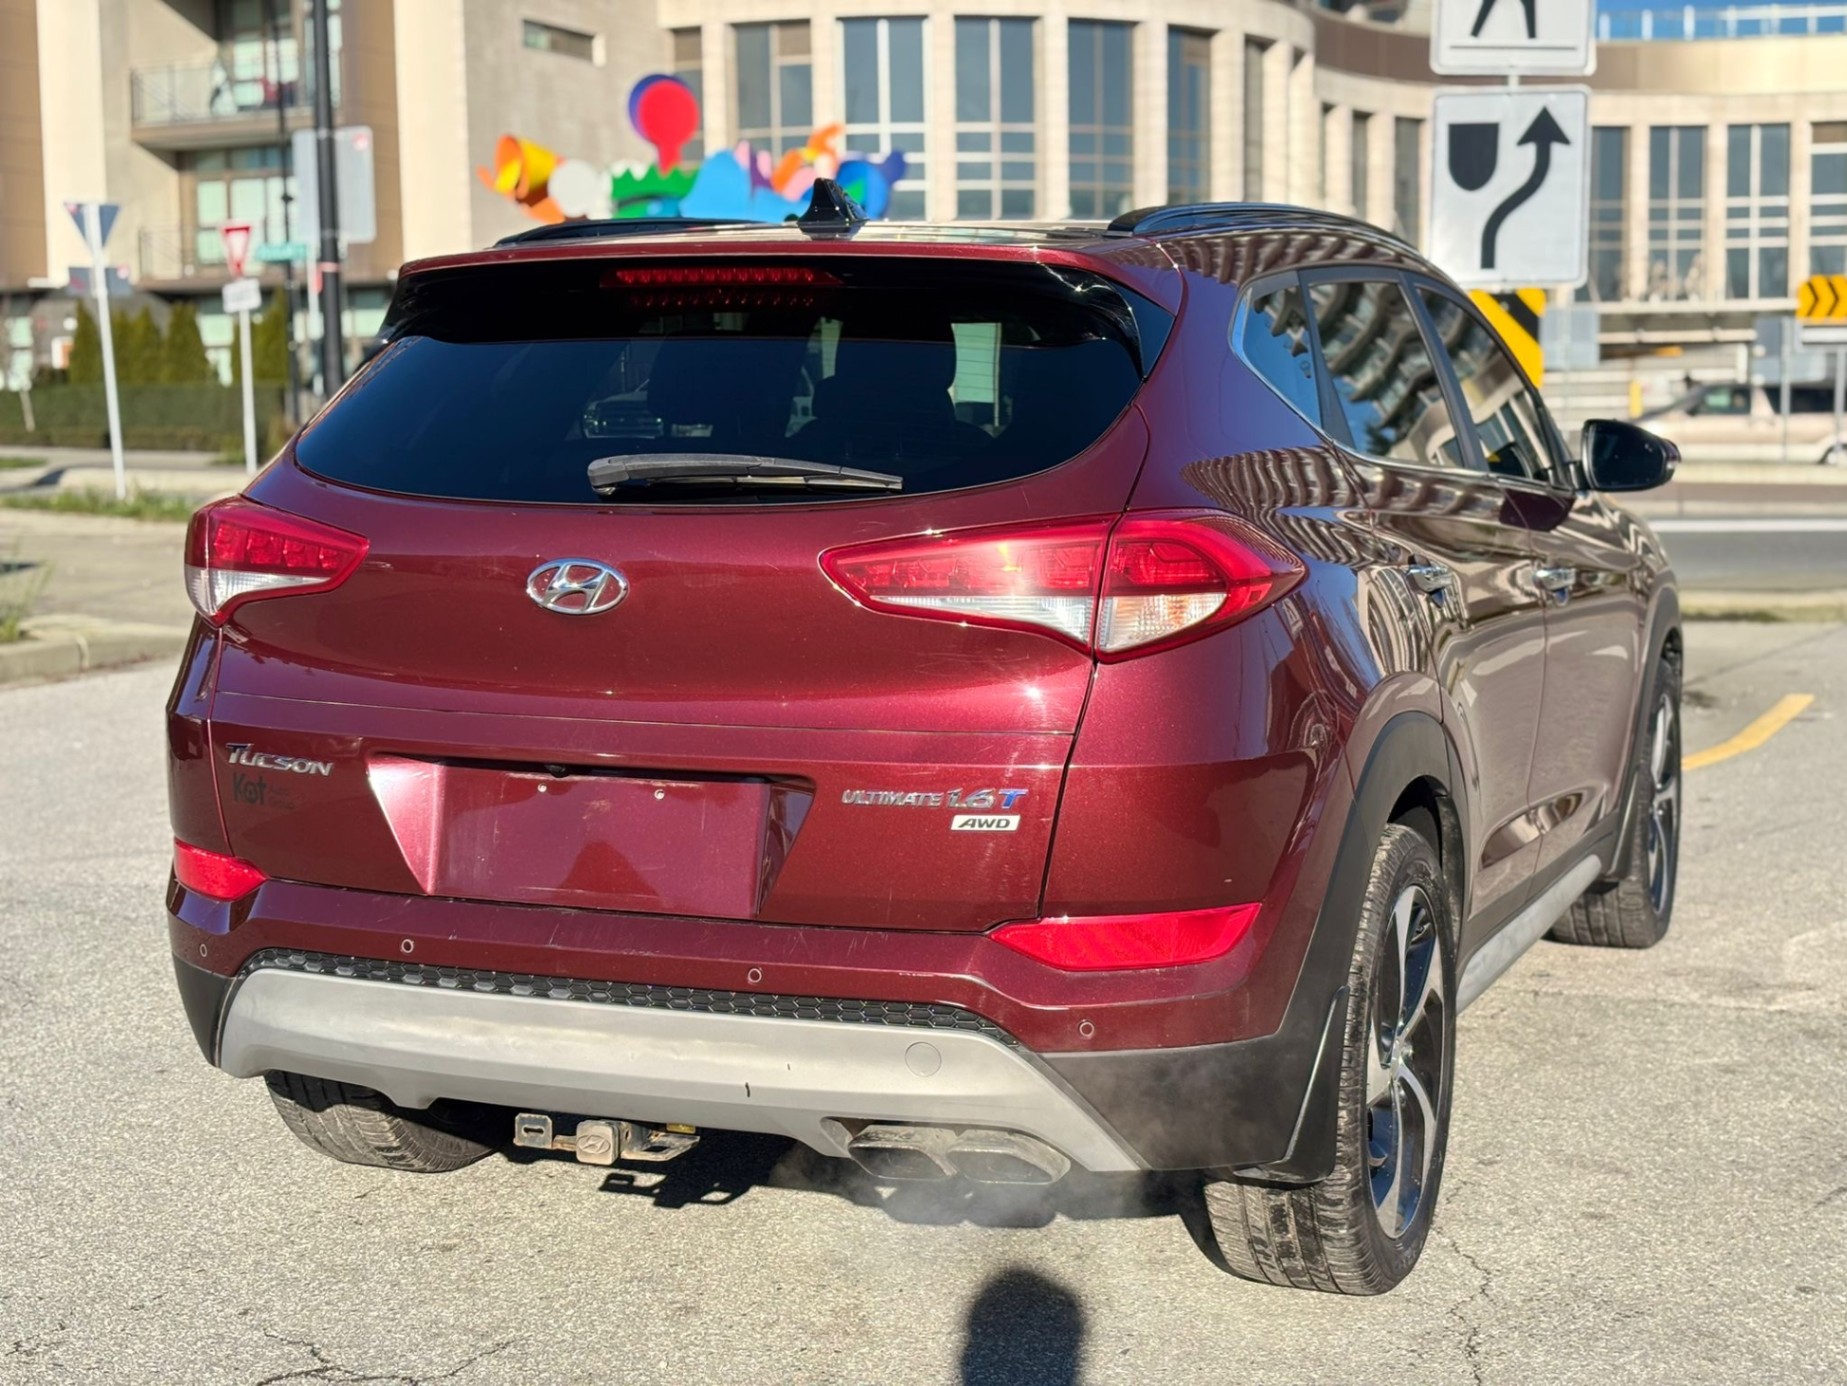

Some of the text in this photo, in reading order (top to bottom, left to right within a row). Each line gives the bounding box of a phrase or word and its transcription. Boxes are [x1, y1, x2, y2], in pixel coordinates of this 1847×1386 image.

[226, 743, 333, 776] TUCSON
[841, 789, 944, 808] ULTIMATE
[958, 818, 1011, 829] AWD
